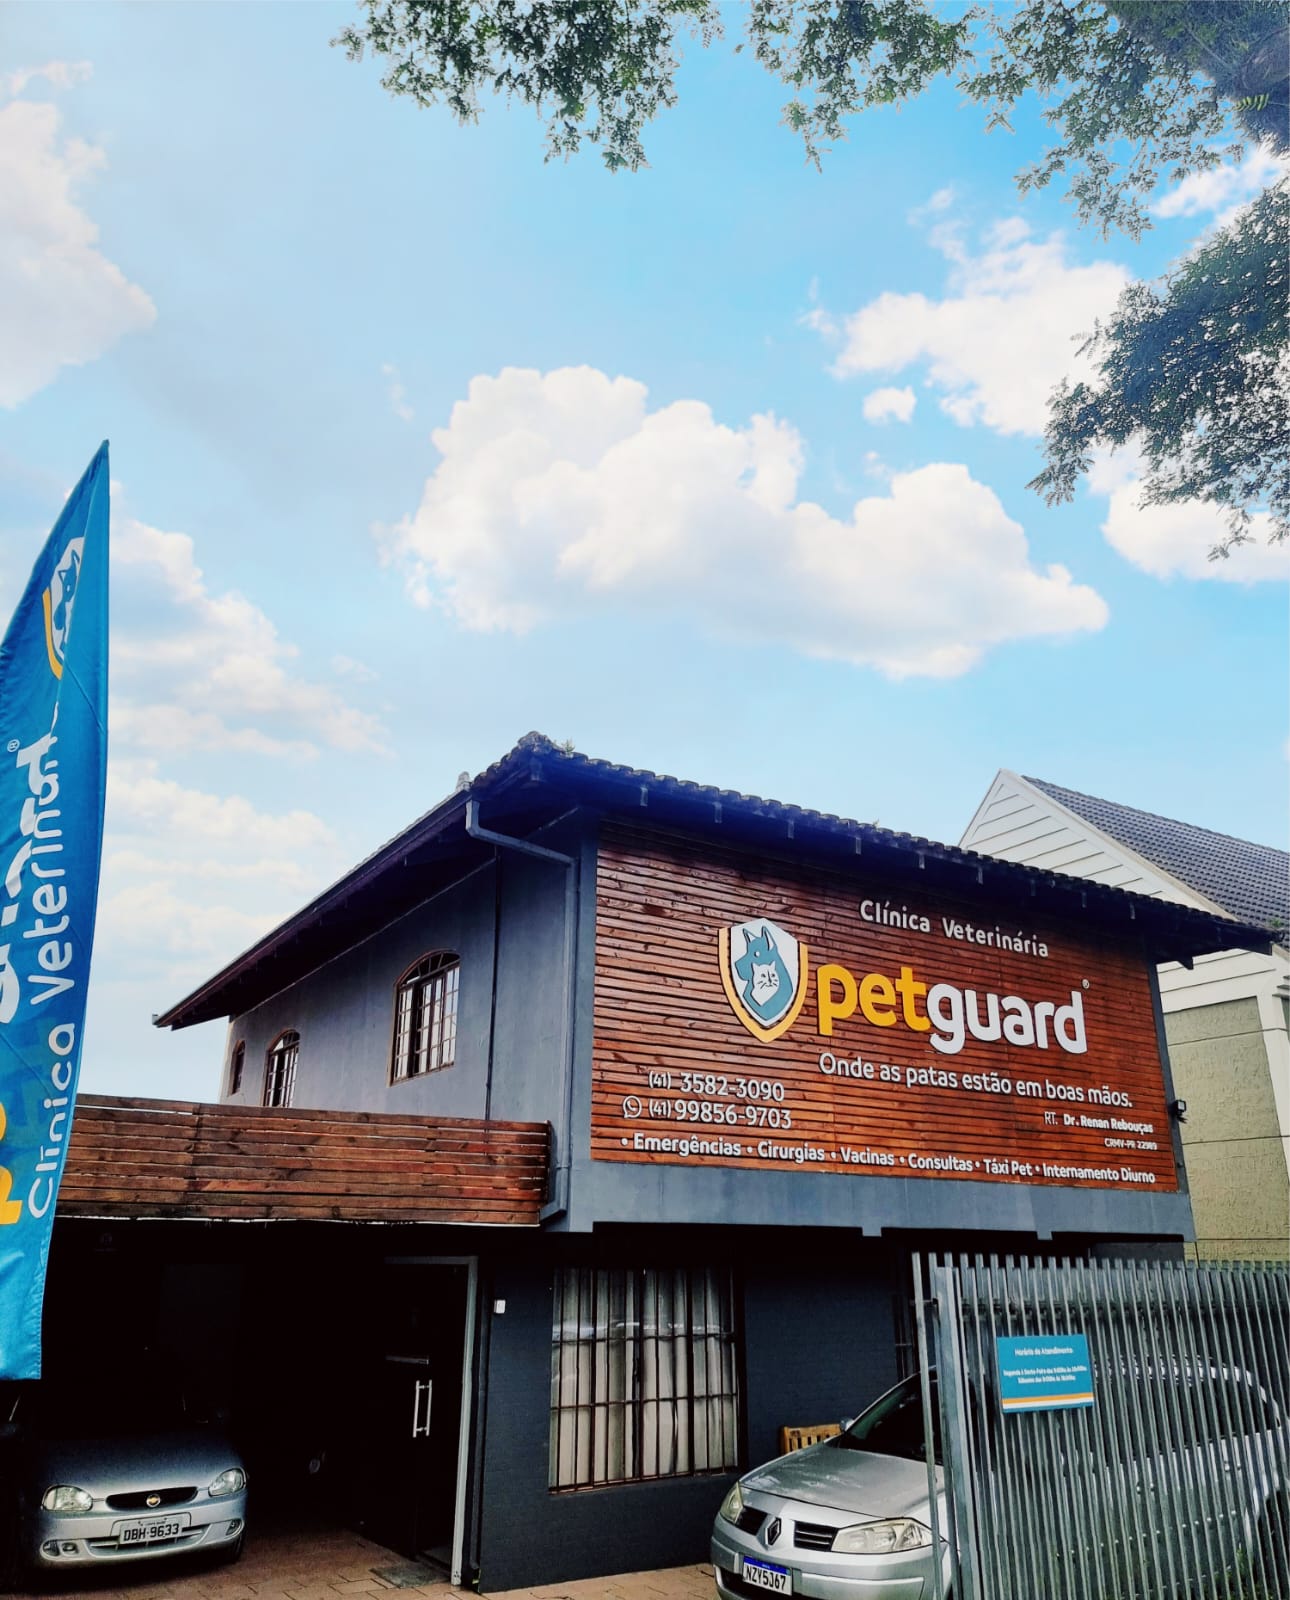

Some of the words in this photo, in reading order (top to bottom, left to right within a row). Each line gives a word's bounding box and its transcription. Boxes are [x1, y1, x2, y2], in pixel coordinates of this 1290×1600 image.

[860, 899, 931, 933] Clínica
[942, 917, 1049, 958] Veterinária
[816, 963, 1088, 1055] petguard
[649, 1070, 672, 1090] (41)
[680, 1071, 785, 1102] 3582-3090
[819, 1052, 875, 1079] Onde
[880, 1064, 901, 1082] as
[906, 1066, 958, 1088] patas
[962, 1071, 1012, 1095] estão
[1016, 1080, 1042, 1098] em
[1045, 1079, 1084, 1102] boas
[1088, 1085, 1133, 1107] mãos.
[649, 1099, 672, 1119] (41)
[674, 1099, 792, 1130] 99856-9703
[1044, 1111, 1058, 1125] RT.
[1063, 1113, 1079, 1126] Dr.
[1080, 1115, 1109, 1129] Renan
[633, 1132, 741, 1157] Emergências
[757, 1140, 825, 1163] Cirurgias
[840, 1146, 895, 1166] Vacinas
[908, 1152, 973, 1172] Consultas
[983, 1157, 1009, 1175] Táxi
[1011, 1160, 1033, 1176] Pet
[1042, 1162, 1119, 1181] Internamento
[1120, 1167, 1156, 1183] Diurno
[746, 1565, 786, 1591] NZY5J67
